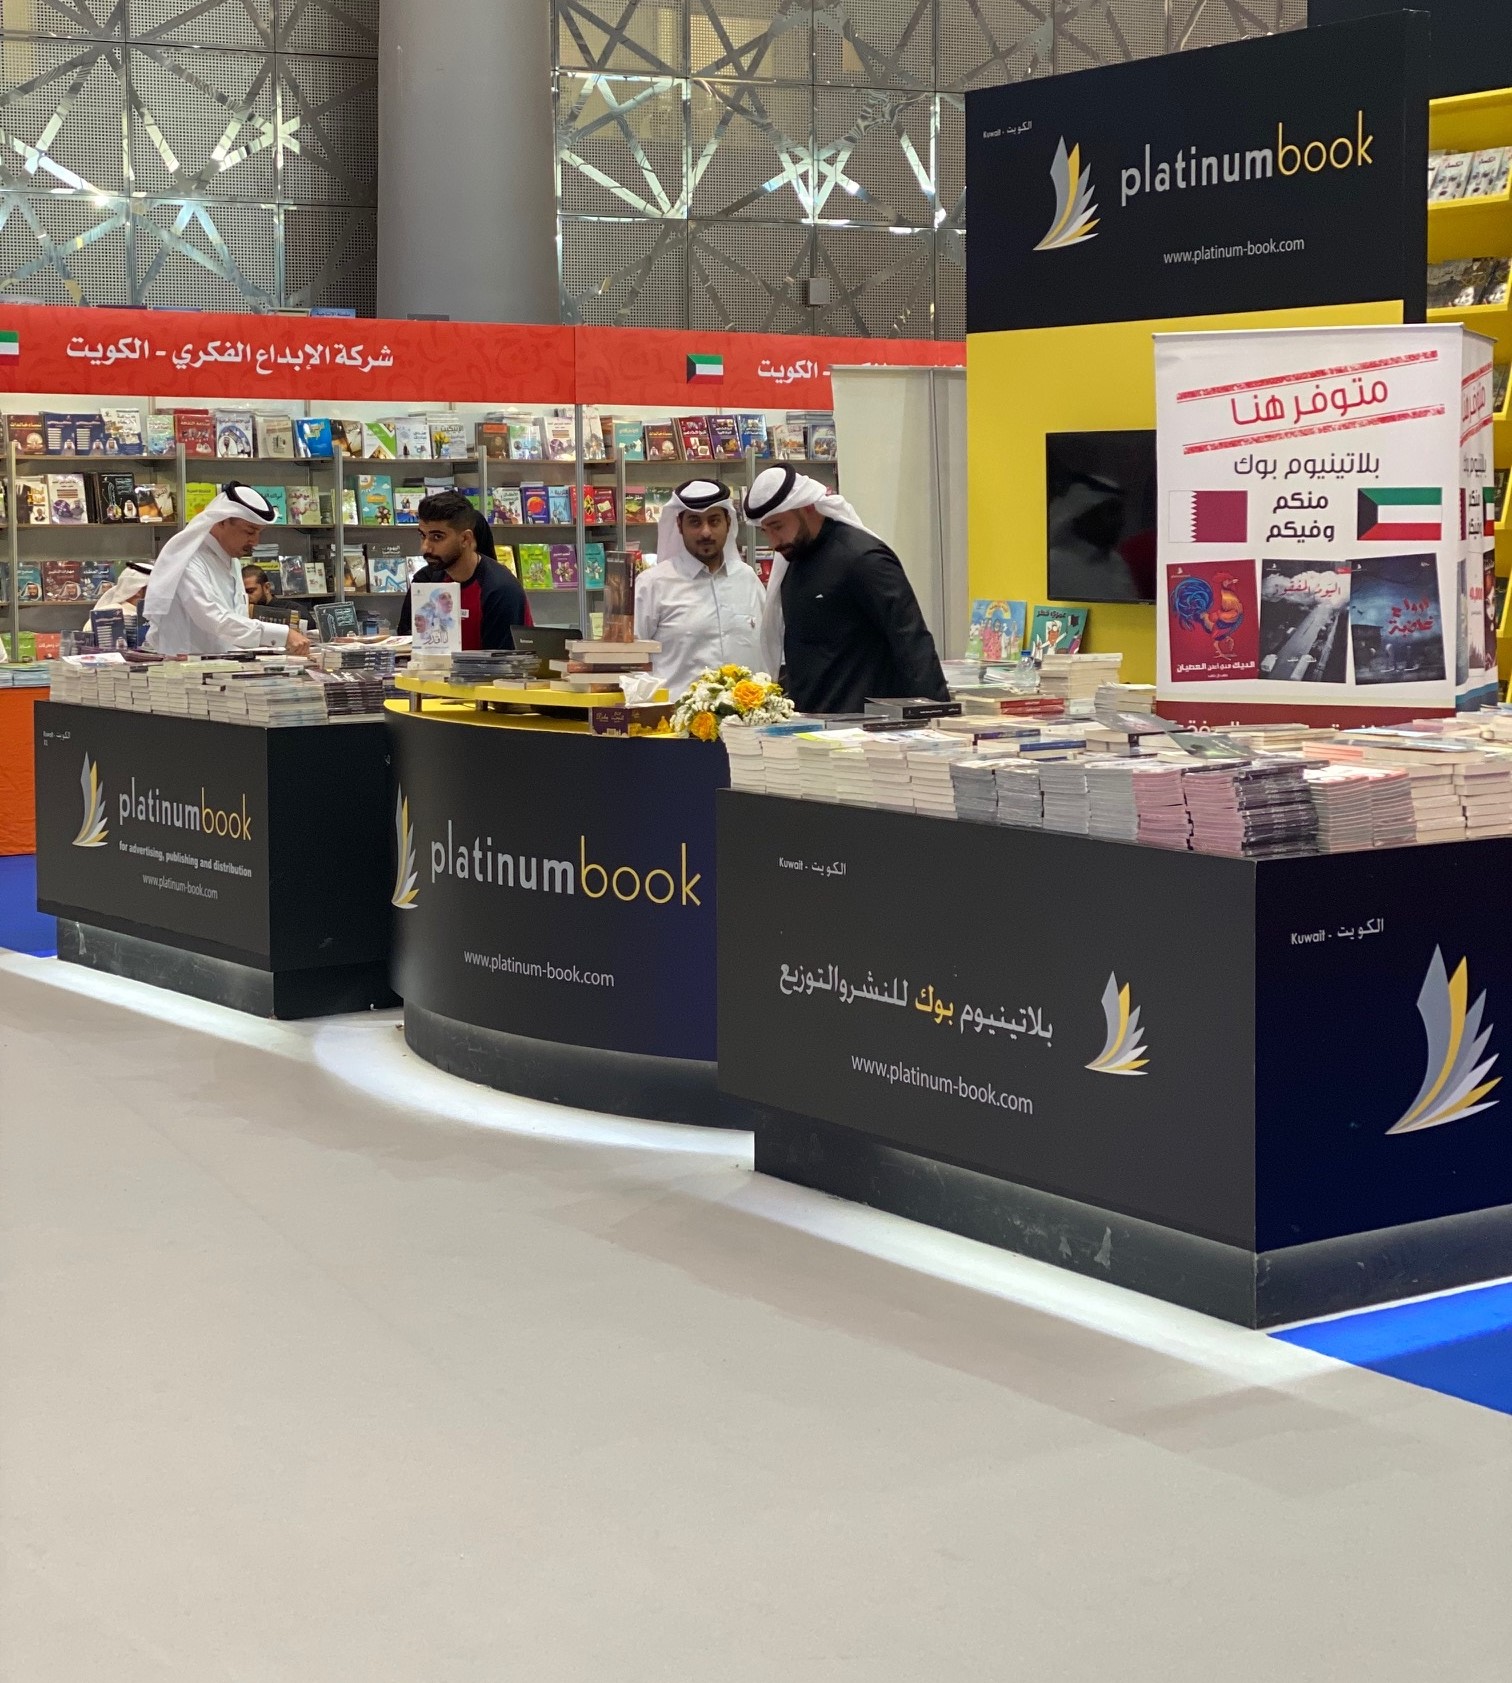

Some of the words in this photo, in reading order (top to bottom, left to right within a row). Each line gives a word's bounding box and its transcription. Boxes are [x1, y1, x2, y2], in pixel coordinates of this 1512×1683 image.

[1163, 236, 1305, 265] www.platinum-book.com
[66, 336, 149, 365] الكويت
[172, 340, 251, 369] الفكري
[256, 343, 330, 375] الإبداع
[335, 343, 394, 373] شركة
[757, 359, 818, 384] الكويت
[1231, 394, 1285, 425] هنا
[1294, 377, 1388, 424] متوفر
[1234, 453, 1277, 480] بوك
[1284, 452, 1379, 480] بلاتينيوم
[1272, 491, 1329, 514] منكم
[1266, 519, 1335, 543] وفيكم
[119, 840, 128, 852] for
[165, 851, 199, 869] publishing
[199, 858, 212, 870] and
[213, 860, 252, 878] distribution
[778, 856, 803, 870] Kuwait
[811, 861, 847, 877] الكويت
[142, 873, 218, 899] www.platinum-book.com
[1290, 930, 1326, 945] Kuwait
[1337, 918, 1384, 940] الكويت
[463, 949, 615, 987] www.platinum-book.com
[914, 984, 954, 1026] بوك
[959, 1003, 1053, 1048] بلاتينيوم
[850, 1053, 1034, 1115] www.platinum-book.com
